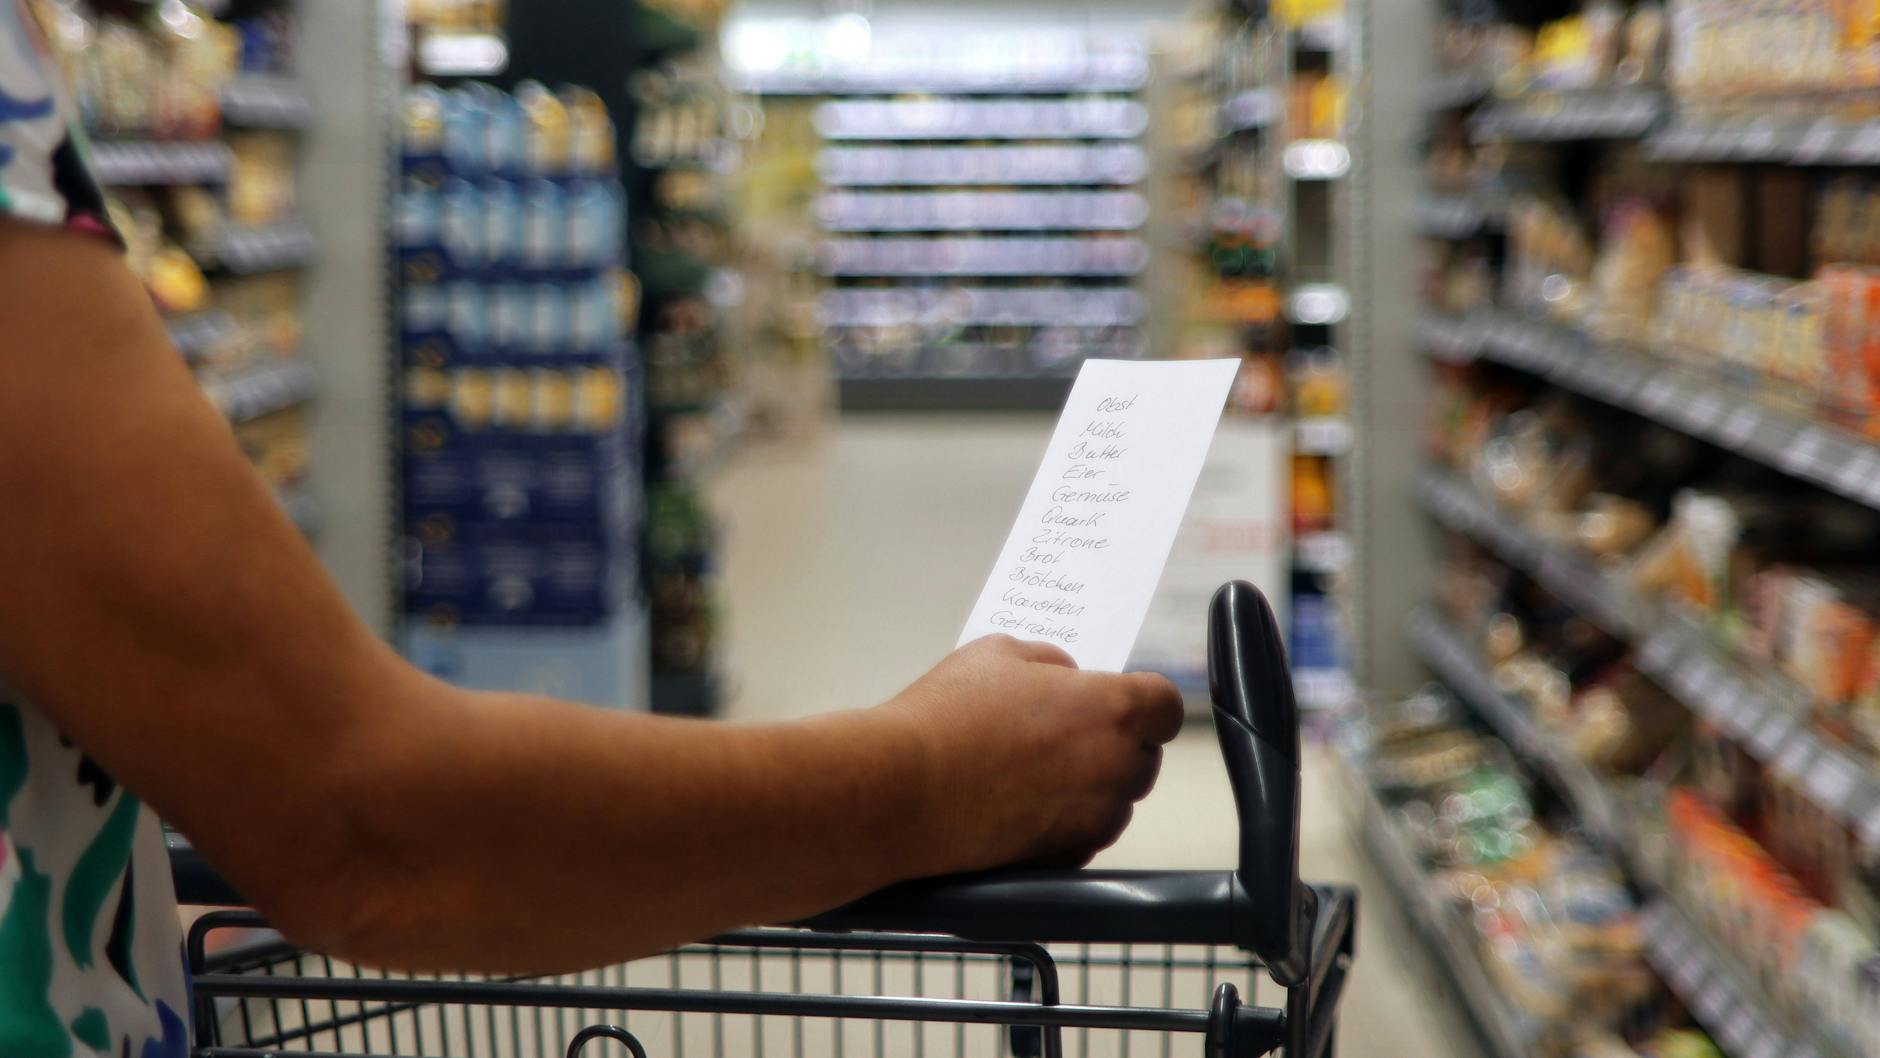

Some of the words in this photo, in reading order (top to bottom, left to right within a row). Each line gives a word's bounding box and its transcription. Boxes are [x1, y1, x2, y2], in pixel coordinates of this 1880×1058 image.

[1096, 394, 1138, 413] Obst
[1079, 420, 1127, 439] Milch
[1067, 441, 1128, 460] Butter
[1062, 464, 1106, 479] Eier
[1051, 483, 1130, 503] Gemüse
[1041, 505, 1106, 527] Quark
[1032, 529, 1111, 549] Zitrone
[1019, 546, 1065, 564] Brot
[1008, 566, 1085, 593] Brötchen
[1002, 587, 1086, 615] Karotten
[990, 610, 1080, 643] Getränke
